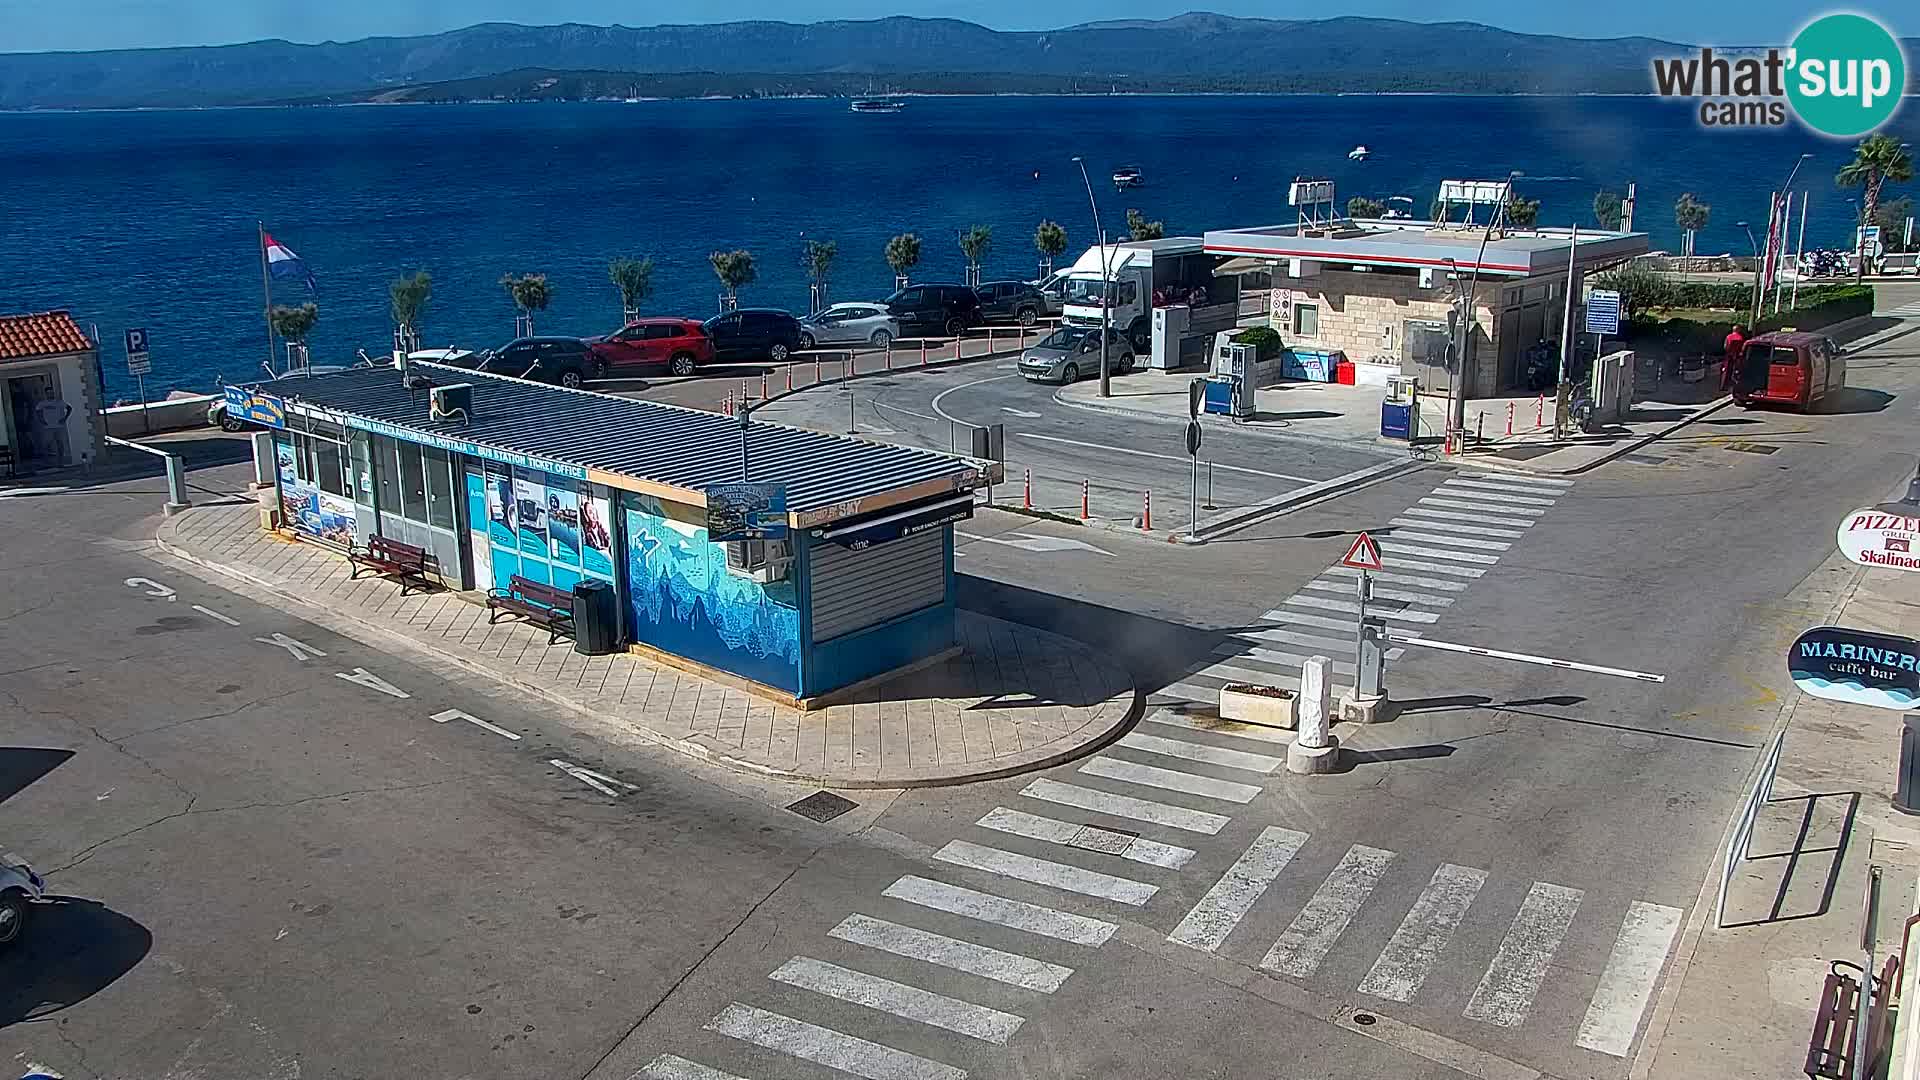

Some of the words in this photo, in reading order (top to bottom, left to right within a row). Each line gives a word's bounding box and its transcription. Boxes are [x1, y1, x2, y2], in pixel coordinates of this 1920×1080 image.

[477, 447, 492, 459] BUS
[493, 450, 526, 465] STATION
[528, 457, 553, 473] TICKET
[555, 464, 582, 478] OFFICE
[1848, 514, 1920, 533] PIZZE
[1881, 530, 1917, 541] GRILL
[1829, 662, 1866, 676] caffe
[1870, 665, 1898, 681] bar
